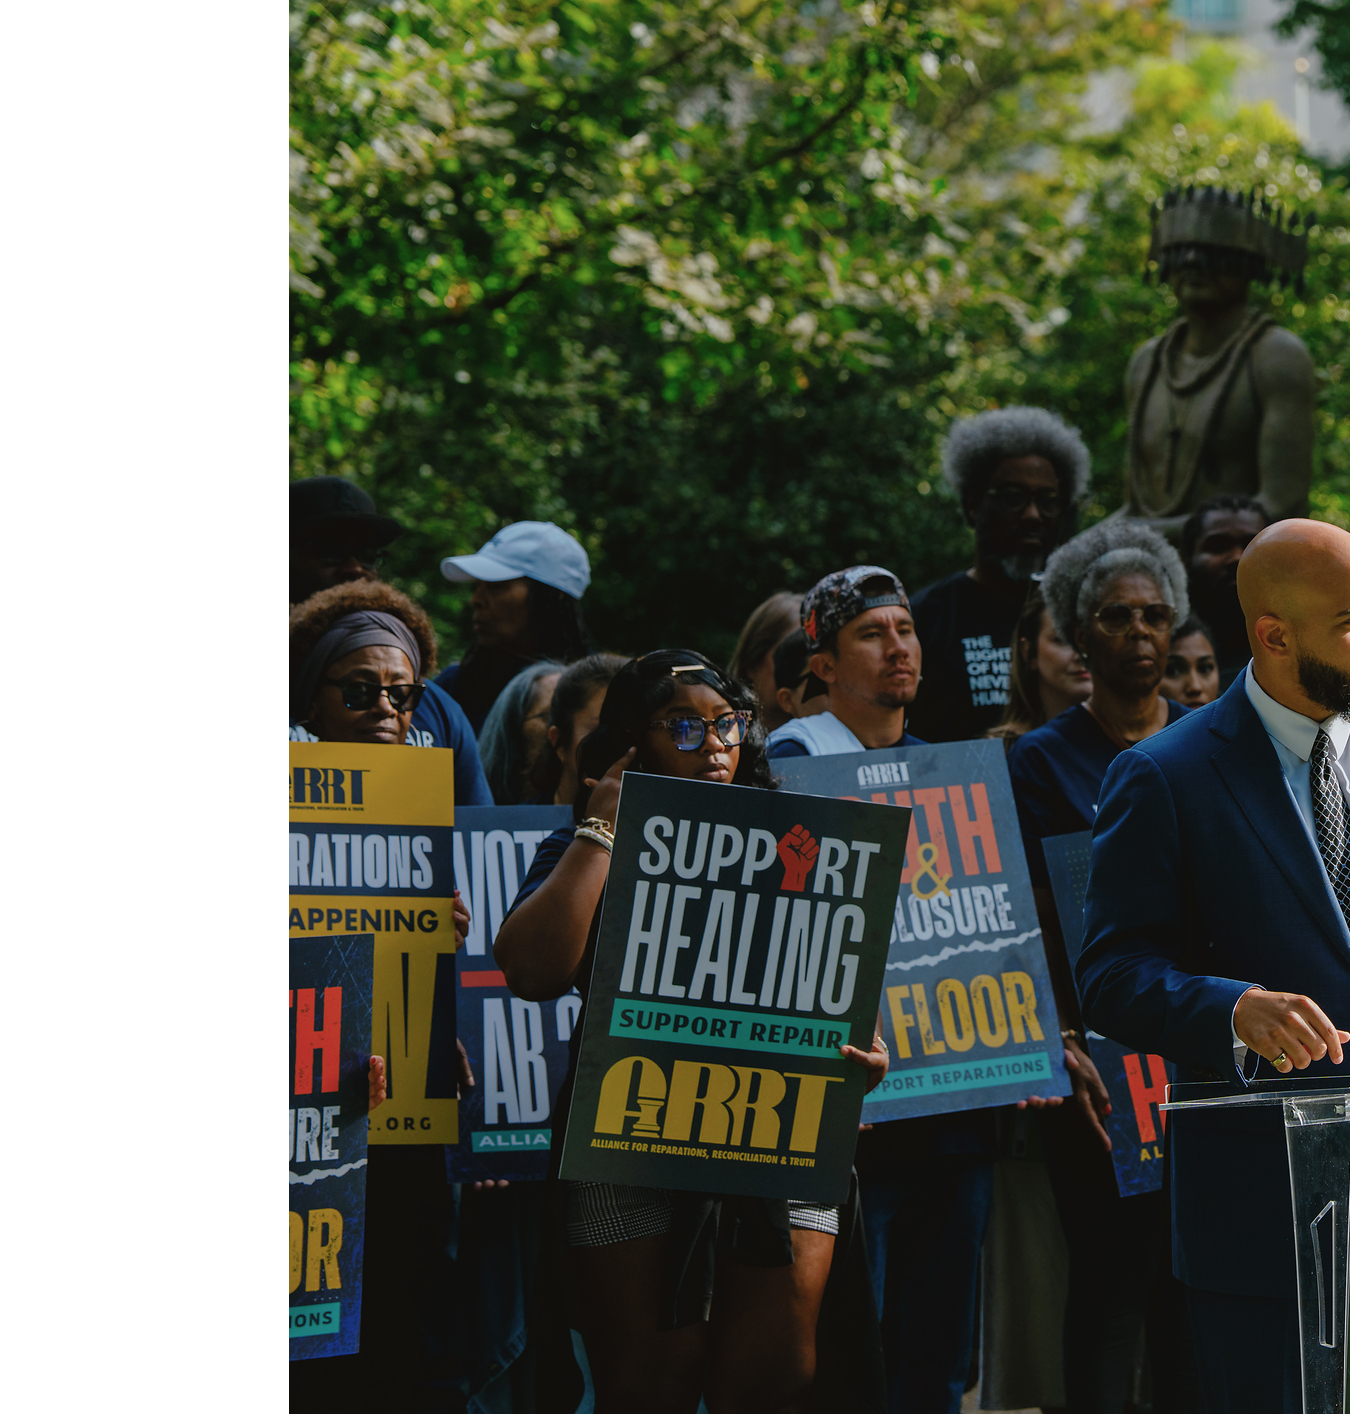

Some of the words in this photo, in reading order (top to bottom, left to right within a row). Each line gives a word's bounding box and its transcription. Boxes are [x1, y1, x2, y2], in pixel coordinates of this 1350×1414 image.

[966, 661, 990, 676] OF
[289, 767, 370, 805] RRT
[889, 883, 1016, 945] LOSURE
[619, 879, 866, 1016] HEALING
[619, 1009, 742, 1039] SUPPORT
[750, 1022, 843, 1050] REPAIR
[886, 971, 1046, 1060] FLOOR
[289, 986, 342, 1095] H
[483, 997, 551, 1125] AB
[932, 1059, 1045, 1086] REPARATIONS
[368, 1116, 432, 1131] .ORG
[594, 1056, 845, 1153] ARRT
[479, 1133, 552, 1147] ALLIA
[590, 1138, 630, 1151] ALLIANCE
[631, 1142, 649, 1152] FOR
[650, 1144, 709, 1160] REPARATIONS,
[711, 1149, 779, 1164] RECONCILIATION
[780, 1156, 788, 1165] &
[790, 1156, 816, 1168] TRUTH
